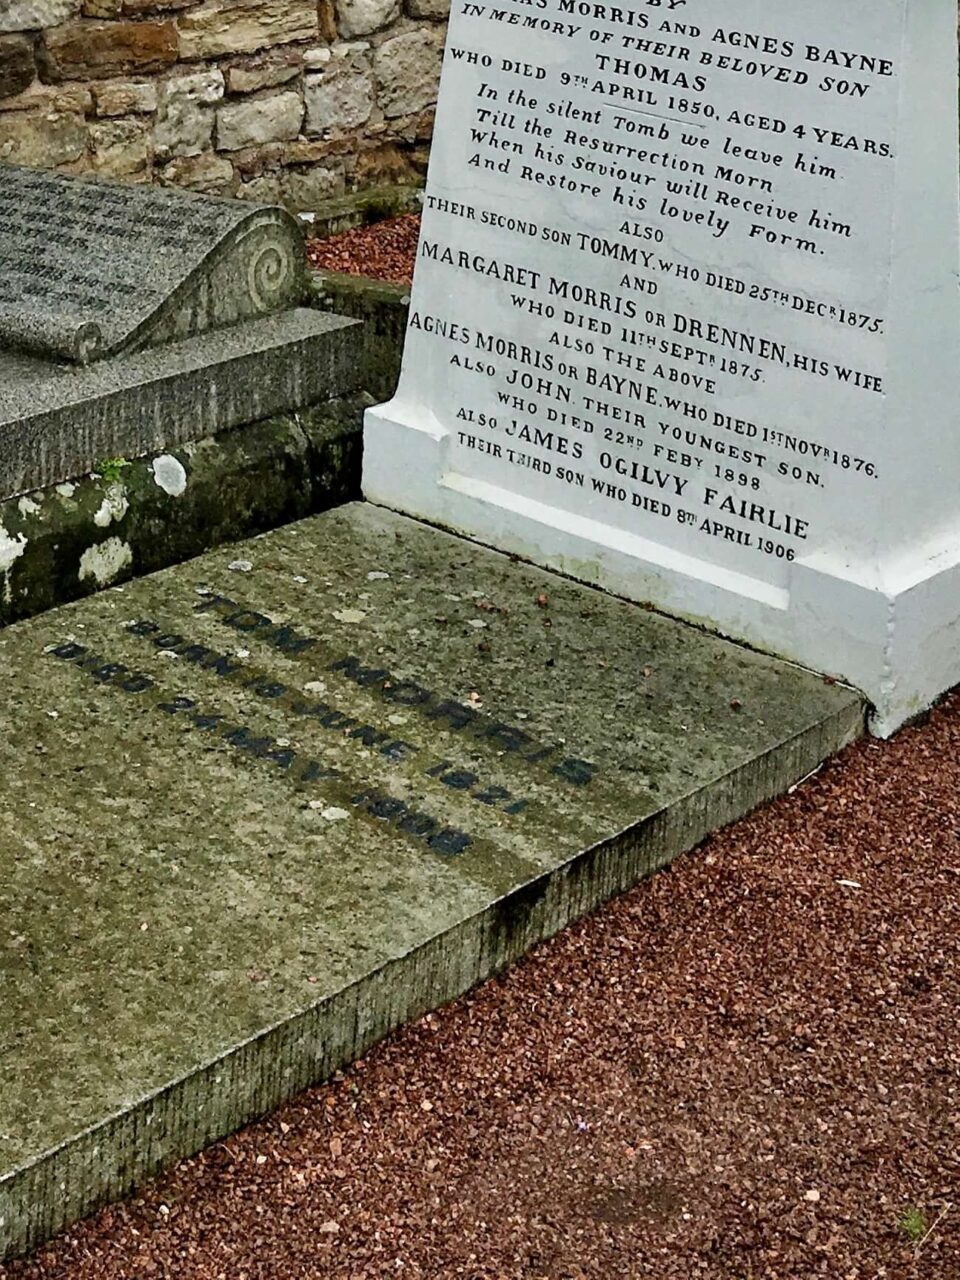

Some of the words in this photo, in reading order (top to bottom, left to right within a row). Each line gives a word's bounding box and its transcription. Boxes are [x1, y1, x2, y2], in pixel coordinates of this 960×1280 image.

[489, 8, 582, 38] MEMORY
[621, 35, 690, 61] THEIR
[699, 51, 808, 85] BELOVED
[818, 76, 871, 98] SON
[595, 53, 707, 92] THOMAS
[711, 28, 795, 58] AGNES
[450, 48, 492, 67] WHO
[501, 59, 546, 80] DIED
[591, 80, 657, 106] APRIL
[726, 110, 786, 133] AGED
[792, 124, 807, 139] 4
[546, 100, 602, 125] silent
[613, 115, 670, 140] Tomb
[723, 137, 783, 167] leave
[470, 128, 523, 155] When
[571, 154, 656, 186] Saviour
[666, 179, 708, 201] will
[714, 190, 798, 223] Receive
[808, 209, 851, 237] him
[477, 108, 515, 129] Till
[563, 129, 705, 176] Resurrection
[714, 165, 772, 193] Morn
[468, 153, 511, 174] And
[520, 165, 601, 198] Restore
[660, 198, 730, 238] lovely
[618, 221, 664, 243] ALSO
[421, 240, 541, 290] MARGARET
[548, 277, 637, 319] MORRIS
[427, 195, 476, 220] THEIR
[480, 211, 537, 236] SECOND
[541, 227, 572, 246] SON
[658, 259, 700, 282] WHO
[705, 272, 746, 295] DIED
[510, 294, 555, 318] WHO
[563, 310, 612, 335] DIED
[409, 312, 470, 344] AGNES
[475, 331, 554, 371] MORRIS
[663, 395, 708, 422] WHO
[712, 412, 757, 437] DIED
[548, 331, 594, 355] ALSO
[652, 364, 716, 394] ABOVE
[450, 354, 496, 377] ALSO
[582, 396, 646, 432] THEIR
[658, 421, 767, 468] YOUNGEST
[497, 391, 538, 415] WHO
[546, 408, 594, 433] DIED
[715, 464, 760, 491] 1898
[456, 407, 497, 429] ALSO
[505, 420, 583, 459] JAMES
[599, 452, 688, 496] OGILVY
[703, 487, 809, 540] FAIRLIE
[457, 431, 502, 458] THEIR
[506, 448, 552, 475] THIRD
[555, 467, 584, 487] SON
[591, 478, 627, 501] WHO
[631, 492, 671, 517] DIED
[699, 518, 753, 546] APRIL
[757, 537, 795, 562] 1906
